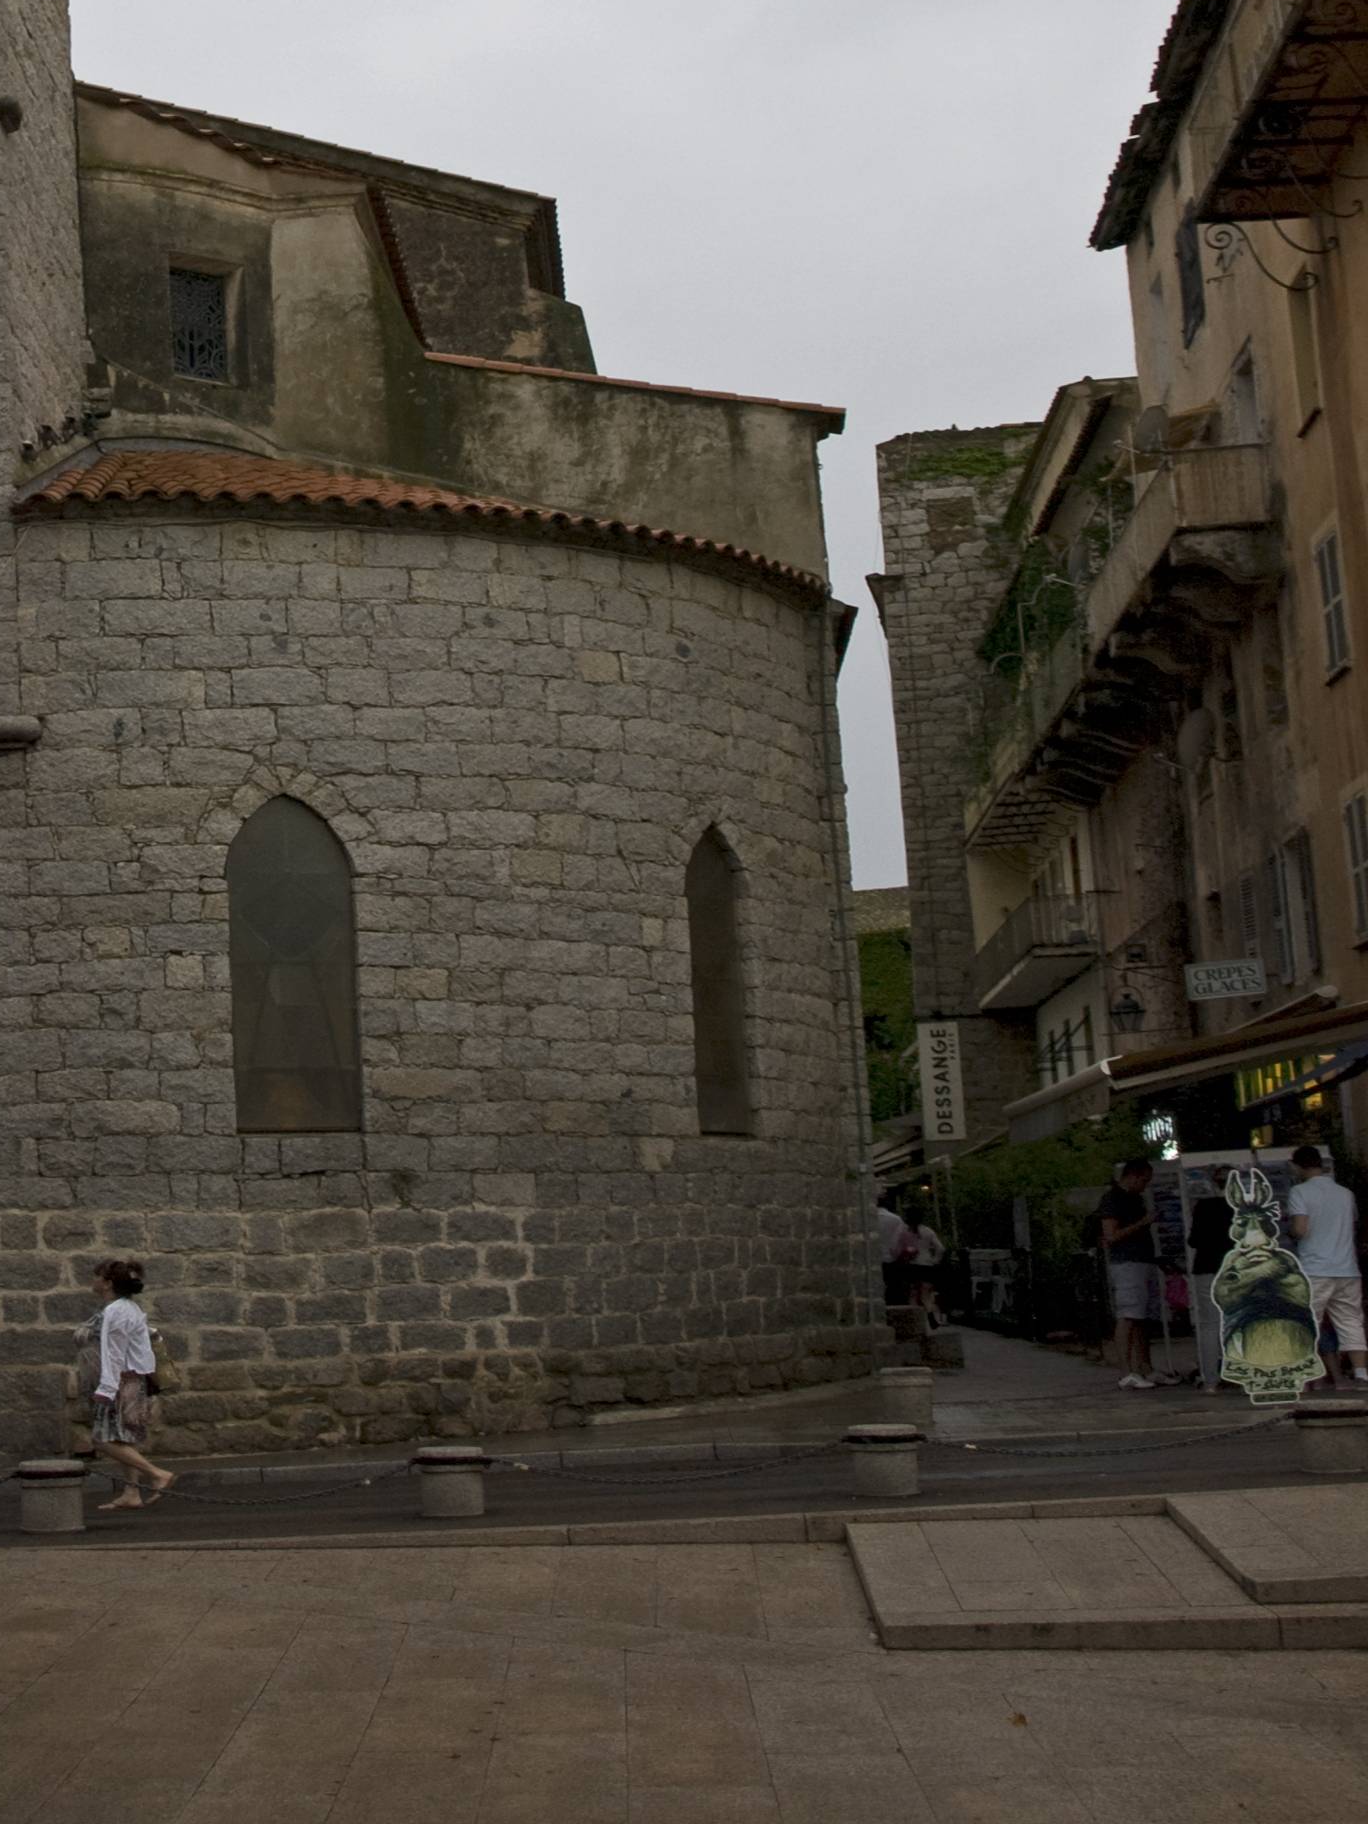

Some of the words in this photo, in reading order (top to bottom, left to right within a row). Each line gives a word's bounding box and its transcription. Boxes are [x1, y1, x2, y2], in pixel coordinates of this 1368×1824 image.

[1193, 966, 1257, 982] CREPES
[1194, 977, 1262, 995] GLACES
[930, 1029, 954, 1135] DESSANGE
